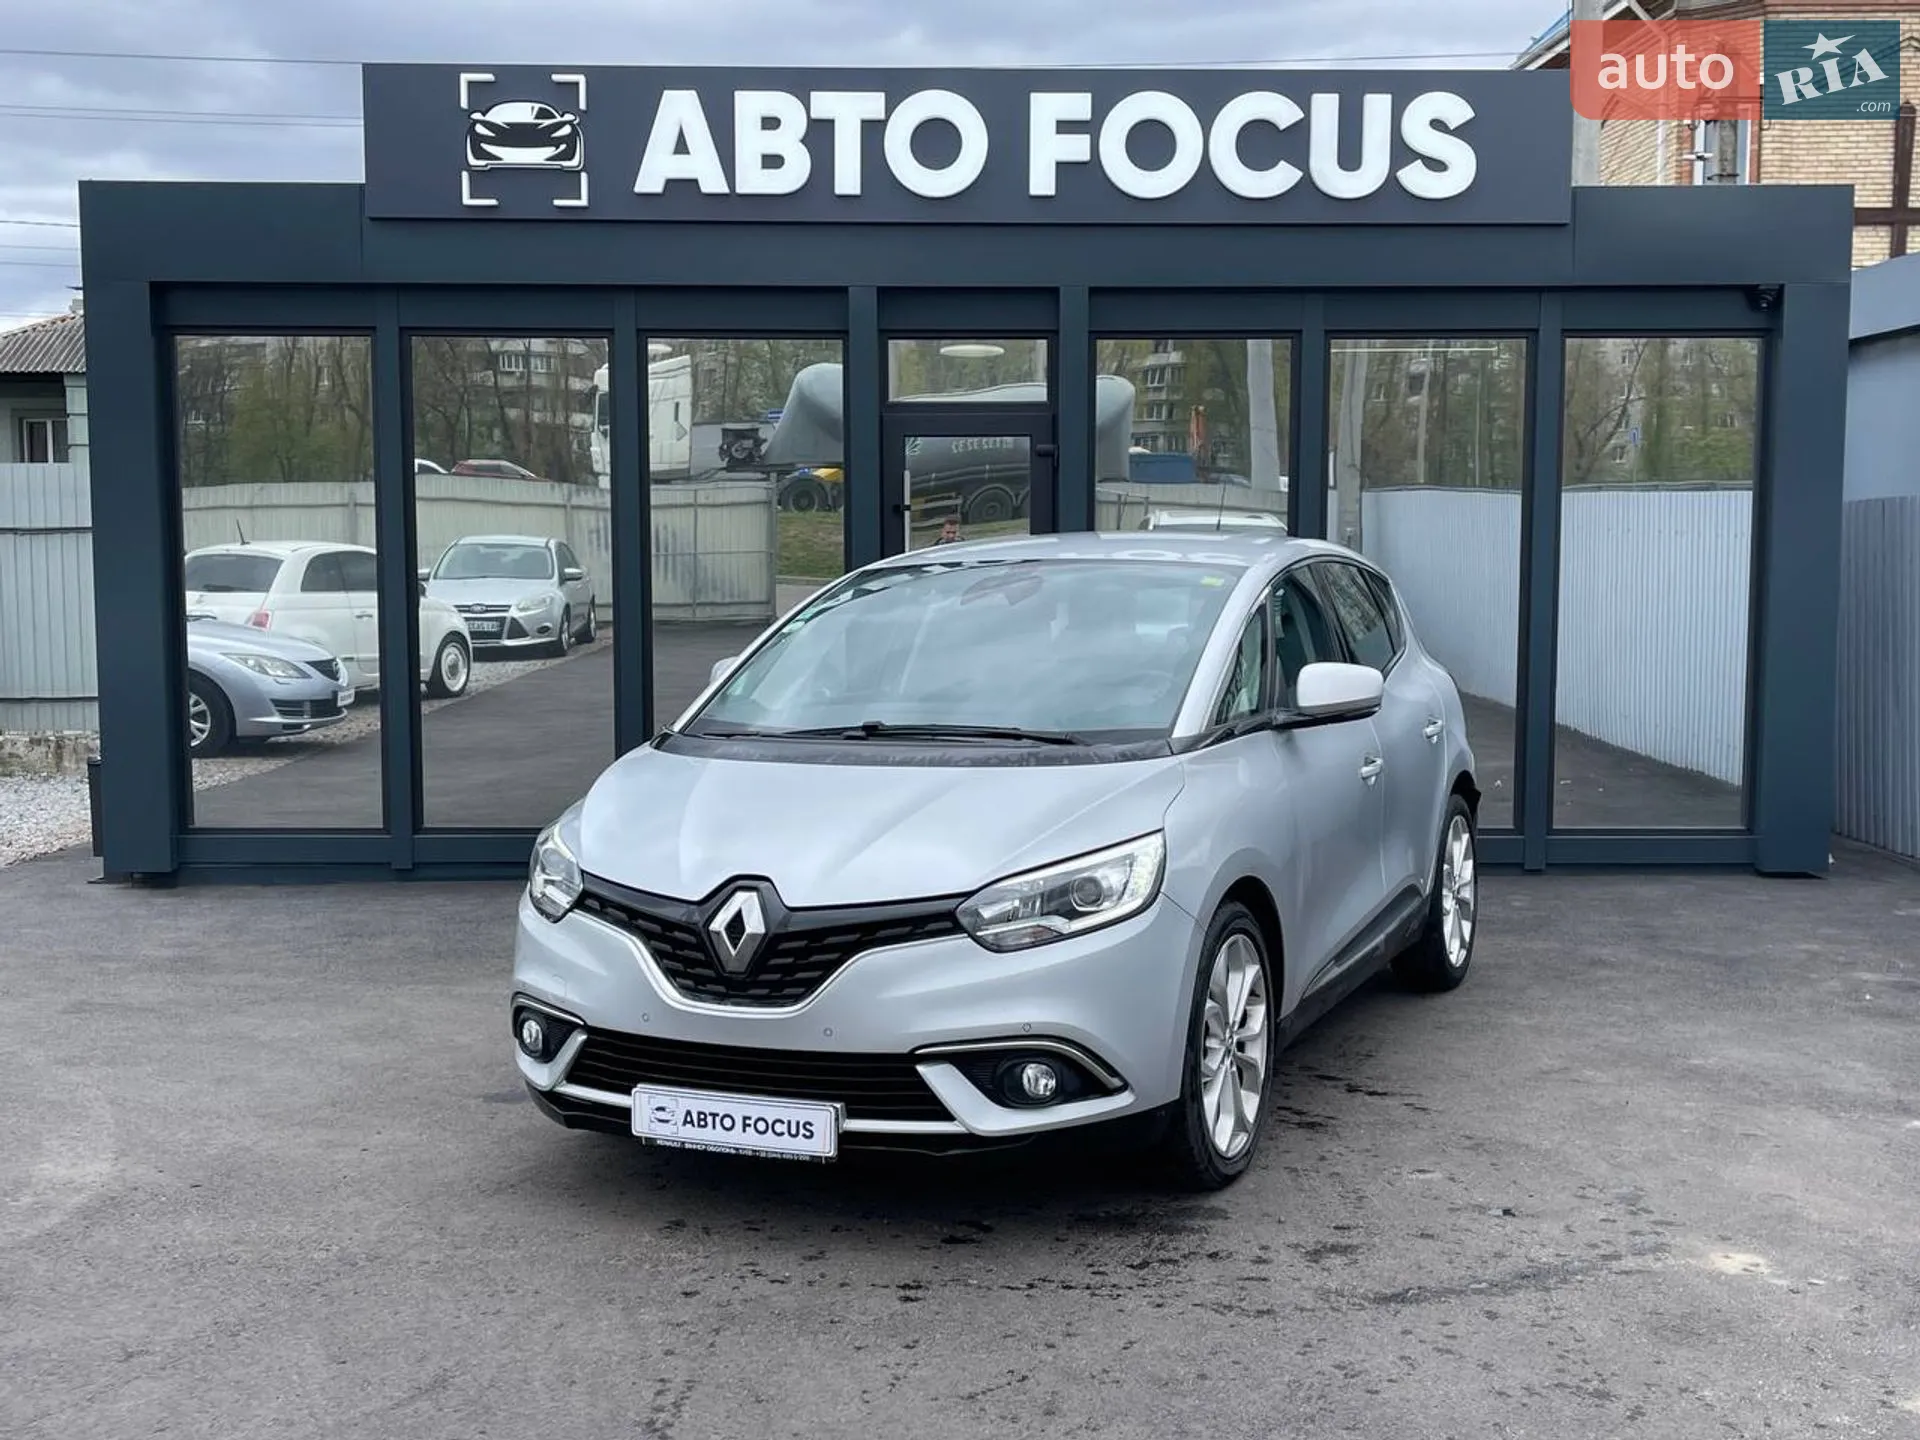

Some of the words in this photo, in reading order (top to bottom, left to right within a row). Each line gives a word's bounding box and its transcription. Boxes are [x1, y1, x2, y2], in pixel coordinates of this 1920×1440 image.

[633, 89, 989, 198] АВТО
[1029, 90, 1477, 200] FOCUS
[682, 1109, 736, 1133] АВТО
[742, 1116, 815, 1140] FOCUS
